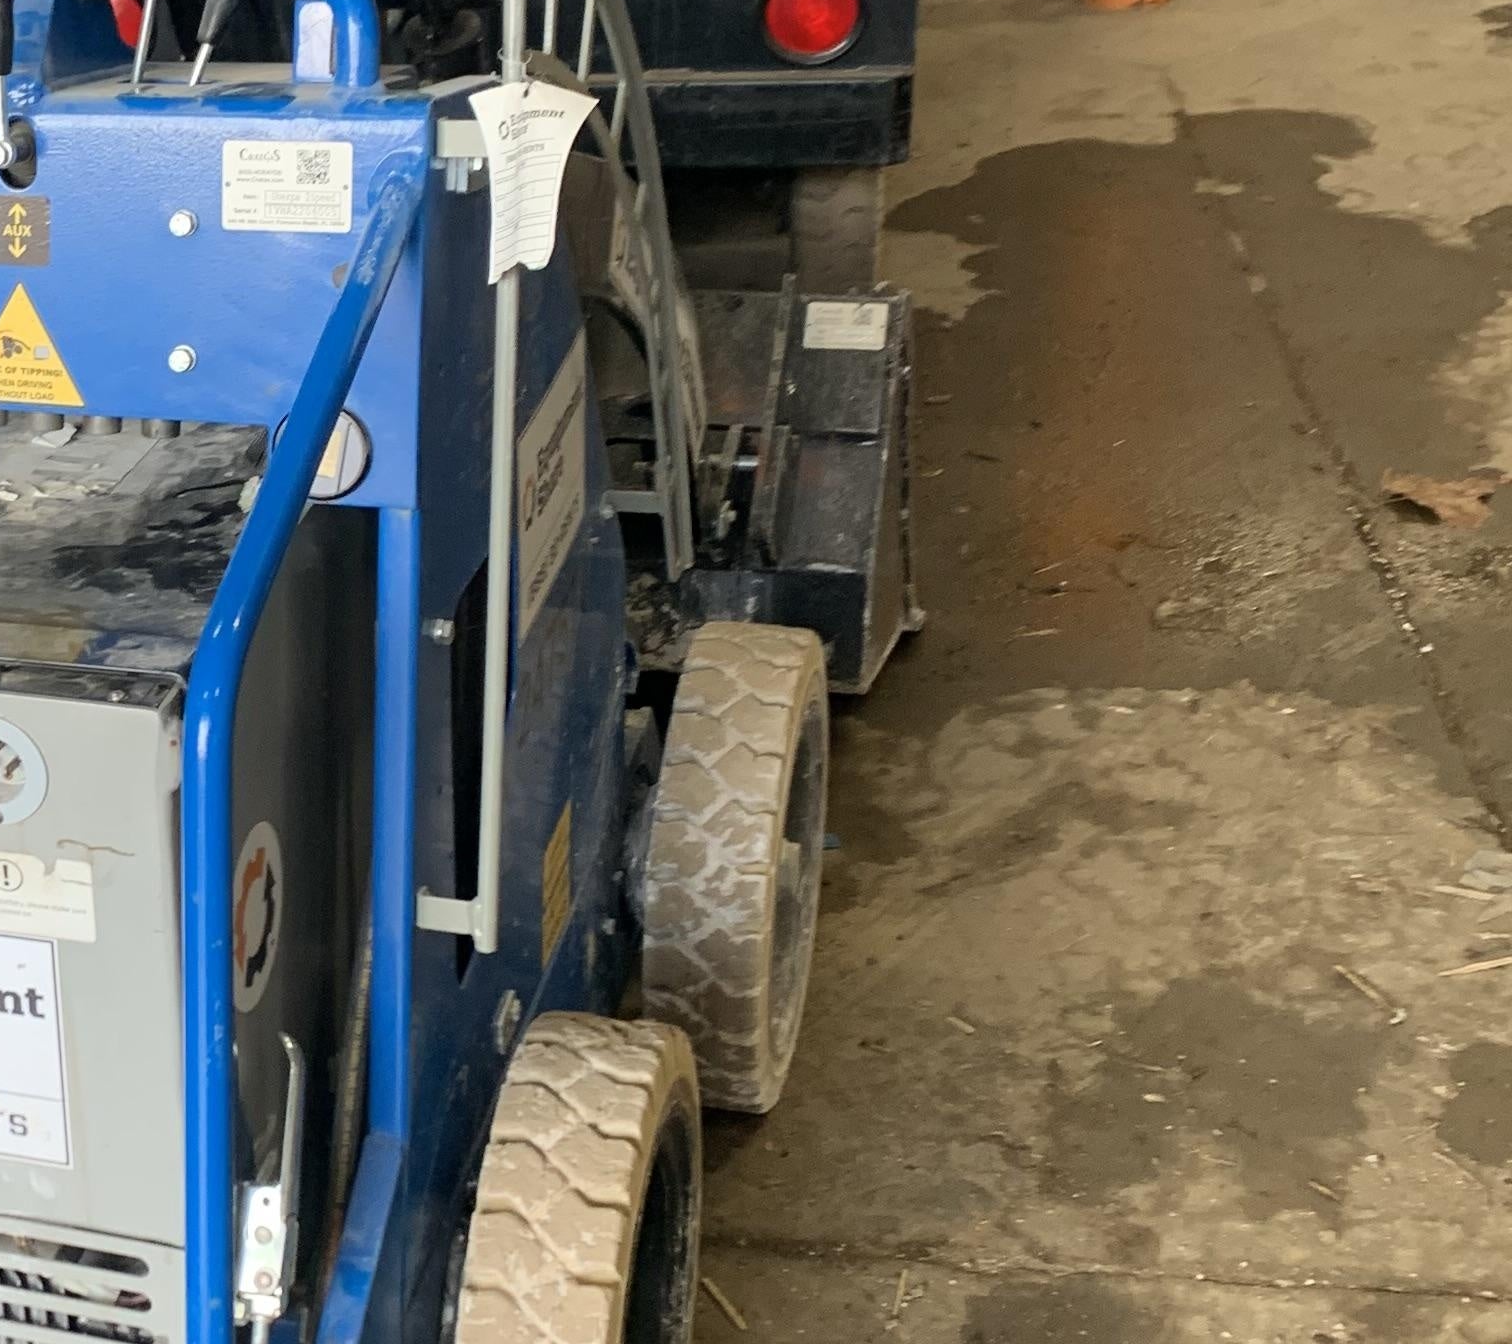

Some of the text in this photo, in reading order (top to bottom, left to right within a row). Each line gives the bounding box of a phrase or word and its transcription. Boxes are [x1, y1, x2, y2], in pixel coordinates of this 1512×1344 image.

[2, 224, 32, 237] AUX
[5, 366, 17, 375] OF
[20, 367, 64, 378] TIPPING!
[17, 380, 53, 390] DRIVING
[29, 391, 55, 401] LOAD
